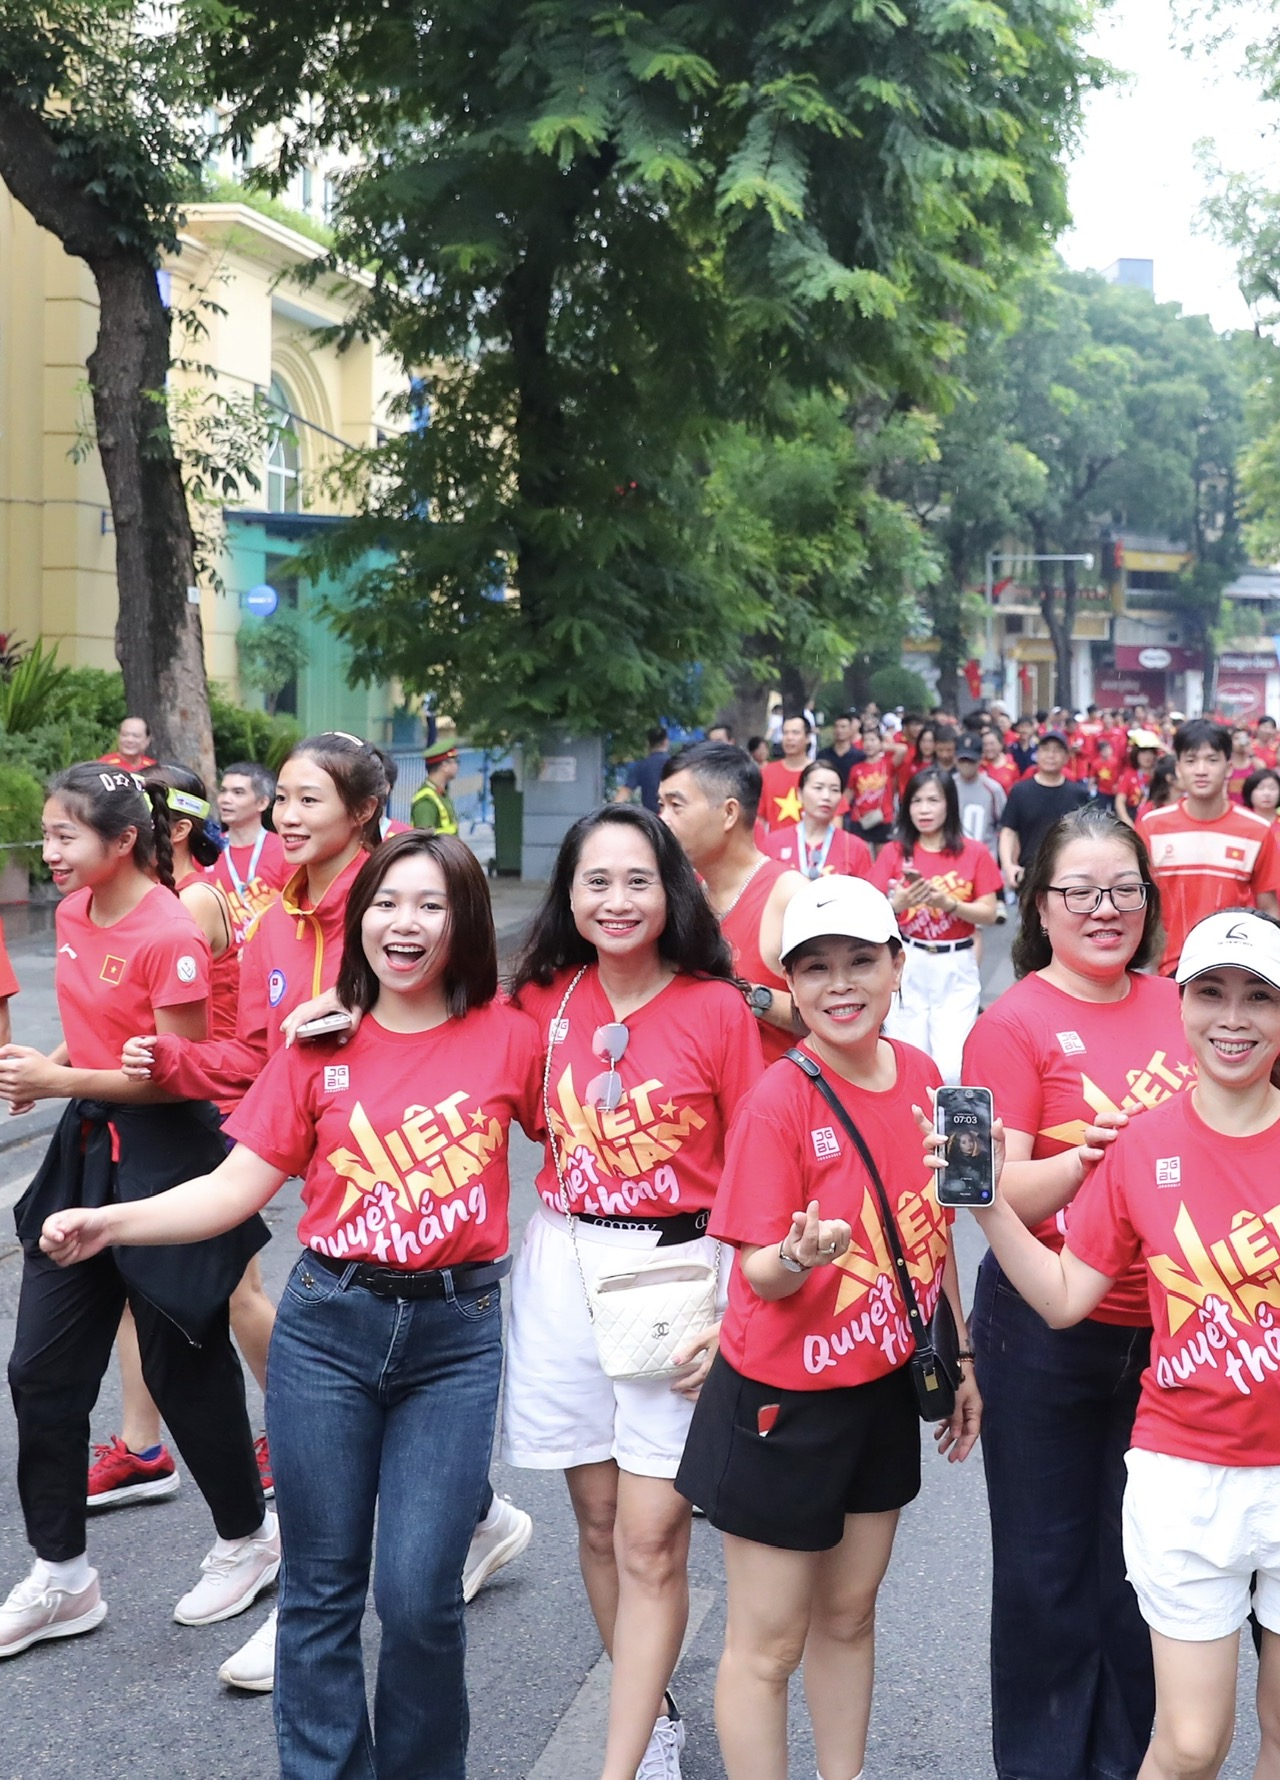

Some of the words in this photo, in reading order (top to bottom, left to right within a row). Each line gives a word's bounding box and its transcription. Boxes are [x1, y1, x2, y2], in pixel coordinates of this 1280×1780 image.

[326, 1090, 470, 1222] VIỆT
[405, 1117, 504, 1211] NAM
[953, 1115, 978, 1124] 07:03
[372, 1183, 487, 1264] thắng
[803, 1273, 897, 1374] Quyết
